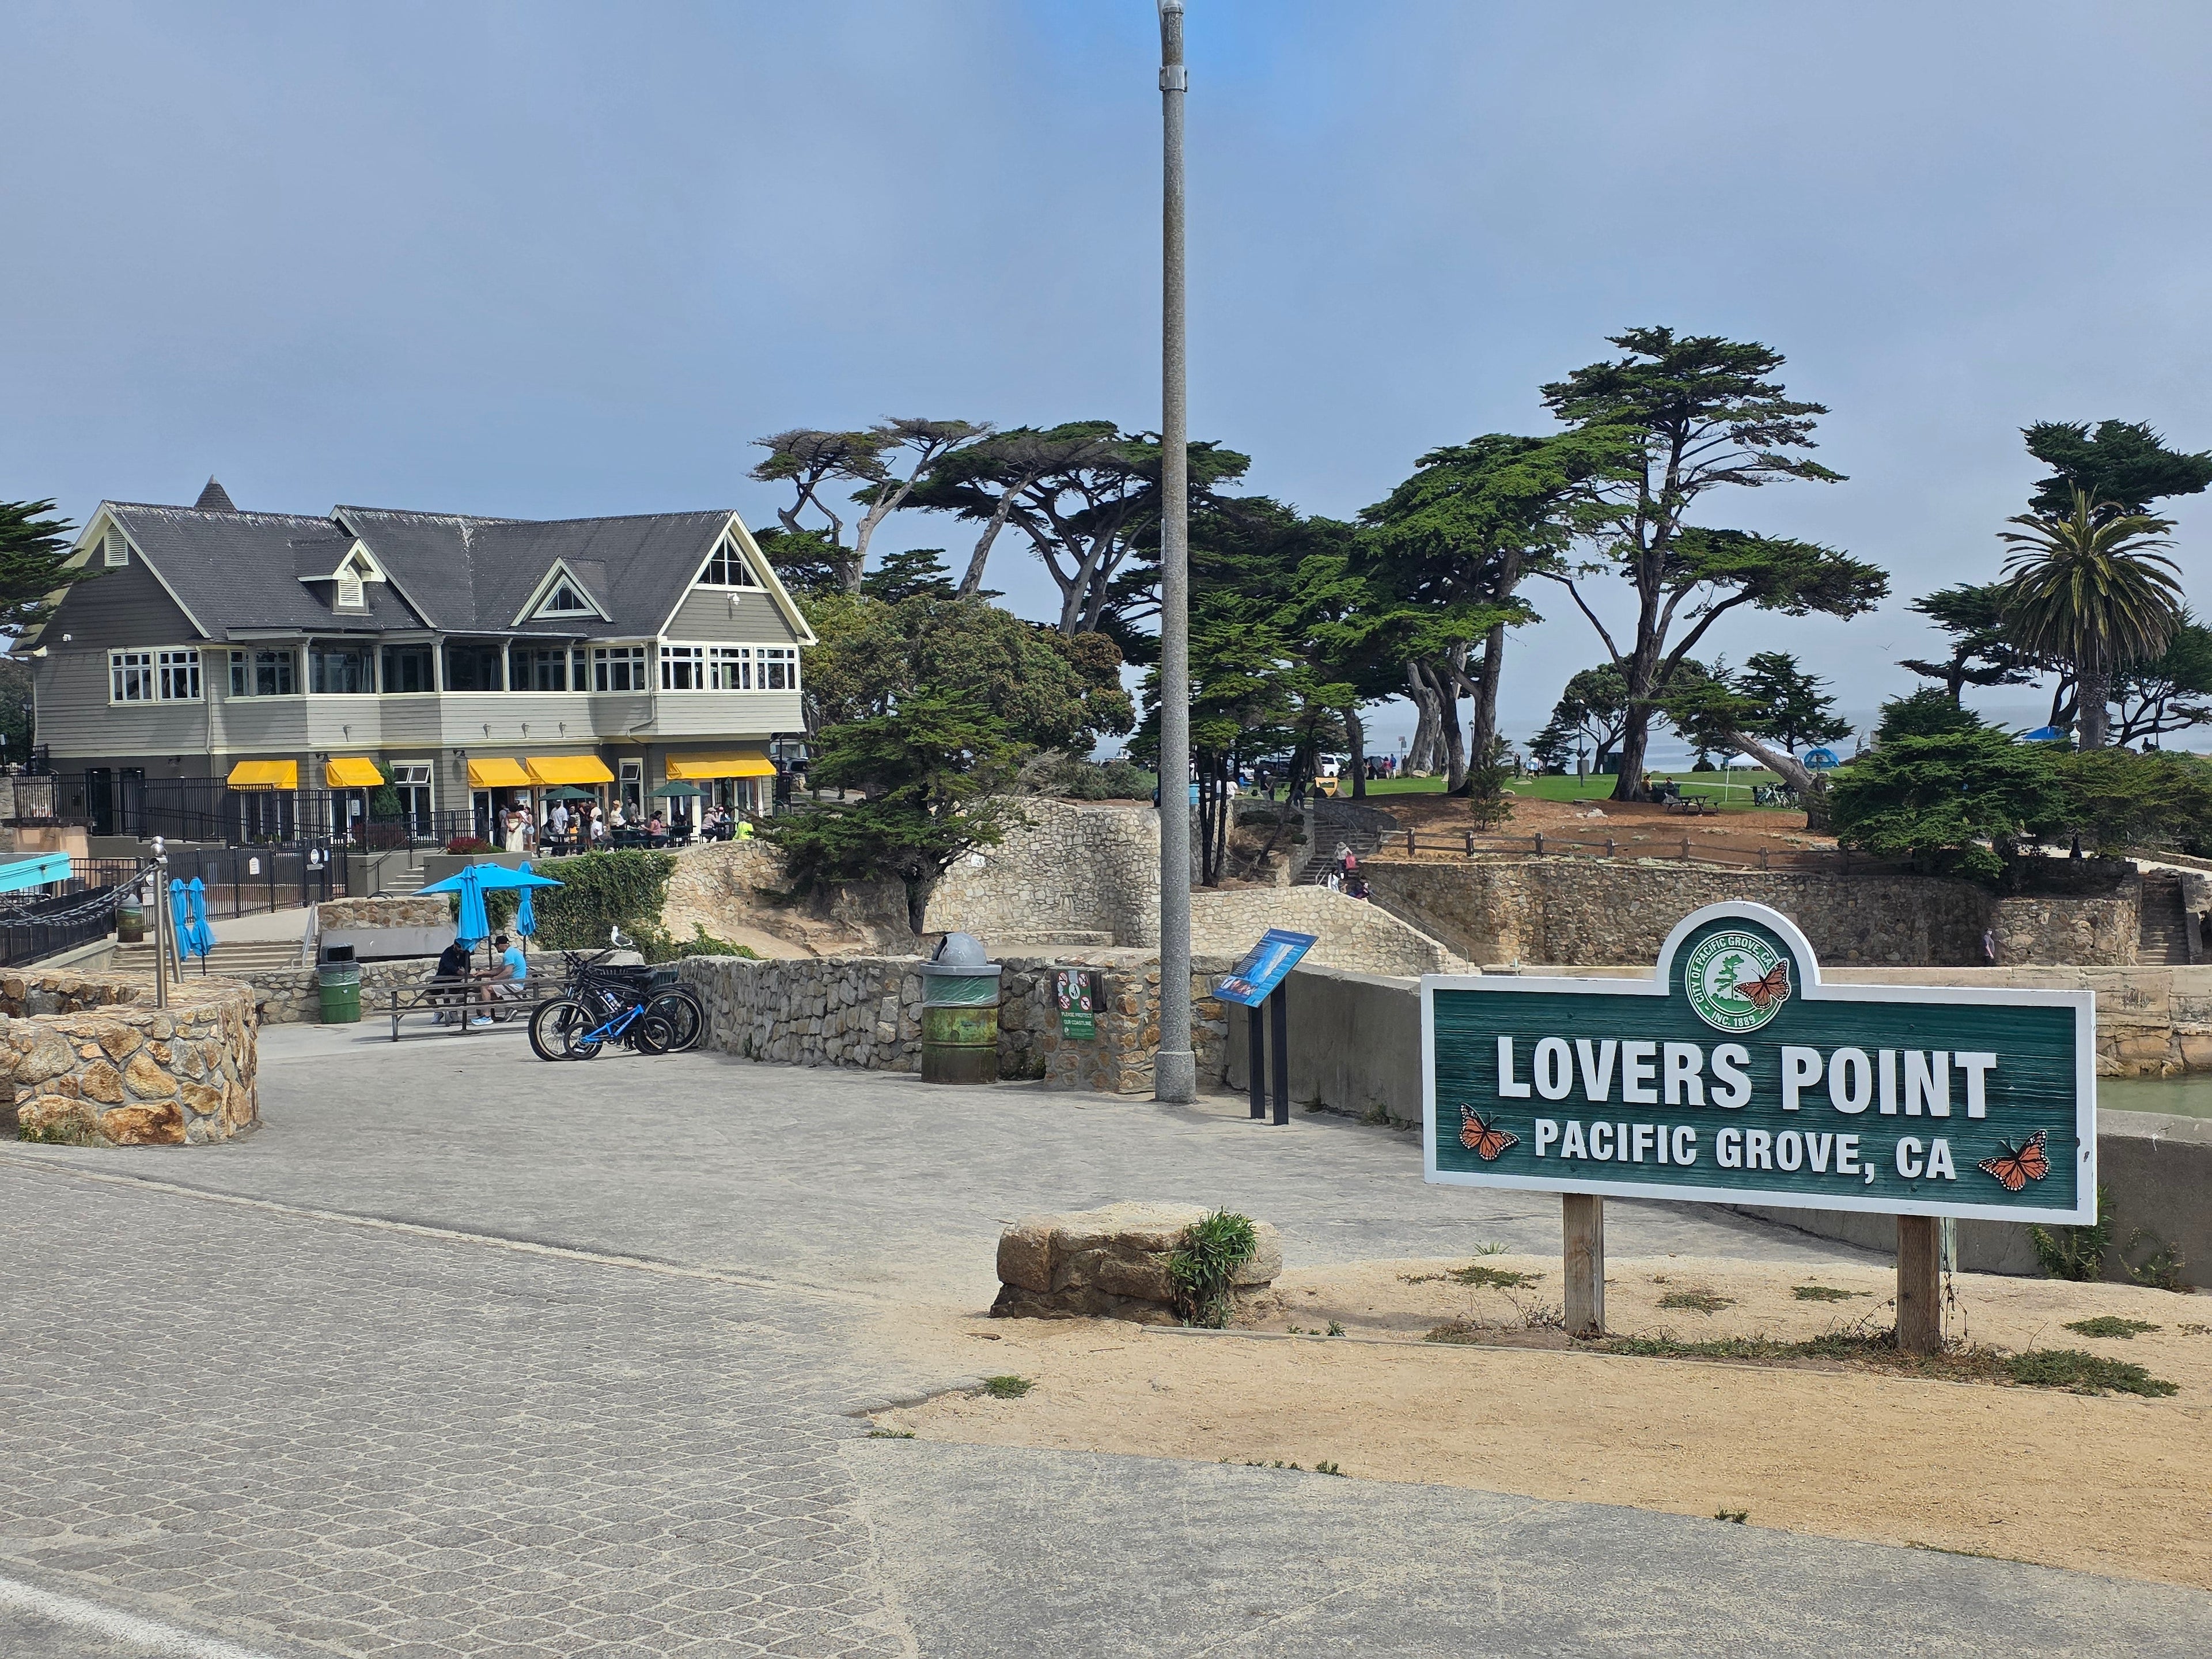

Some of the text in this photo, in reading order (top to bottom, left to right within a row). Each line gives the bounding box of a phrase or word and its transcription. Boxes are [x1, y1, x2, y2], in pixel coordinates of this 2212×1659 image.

[1695, 938, 1726, 965] PACIFIC
[1760, 952, 1774, 969] CA
[1691, 967, 1702, 979] OF
[1691, 982, 1705, 1003] CITY
[1711, 1011, 1756, 1027] INC. 1889
[1498, 1036, 1997, 1118] LOVERS POINT
[1535, 1118, 1957, 1184] PACIFIC GROVE, CA
